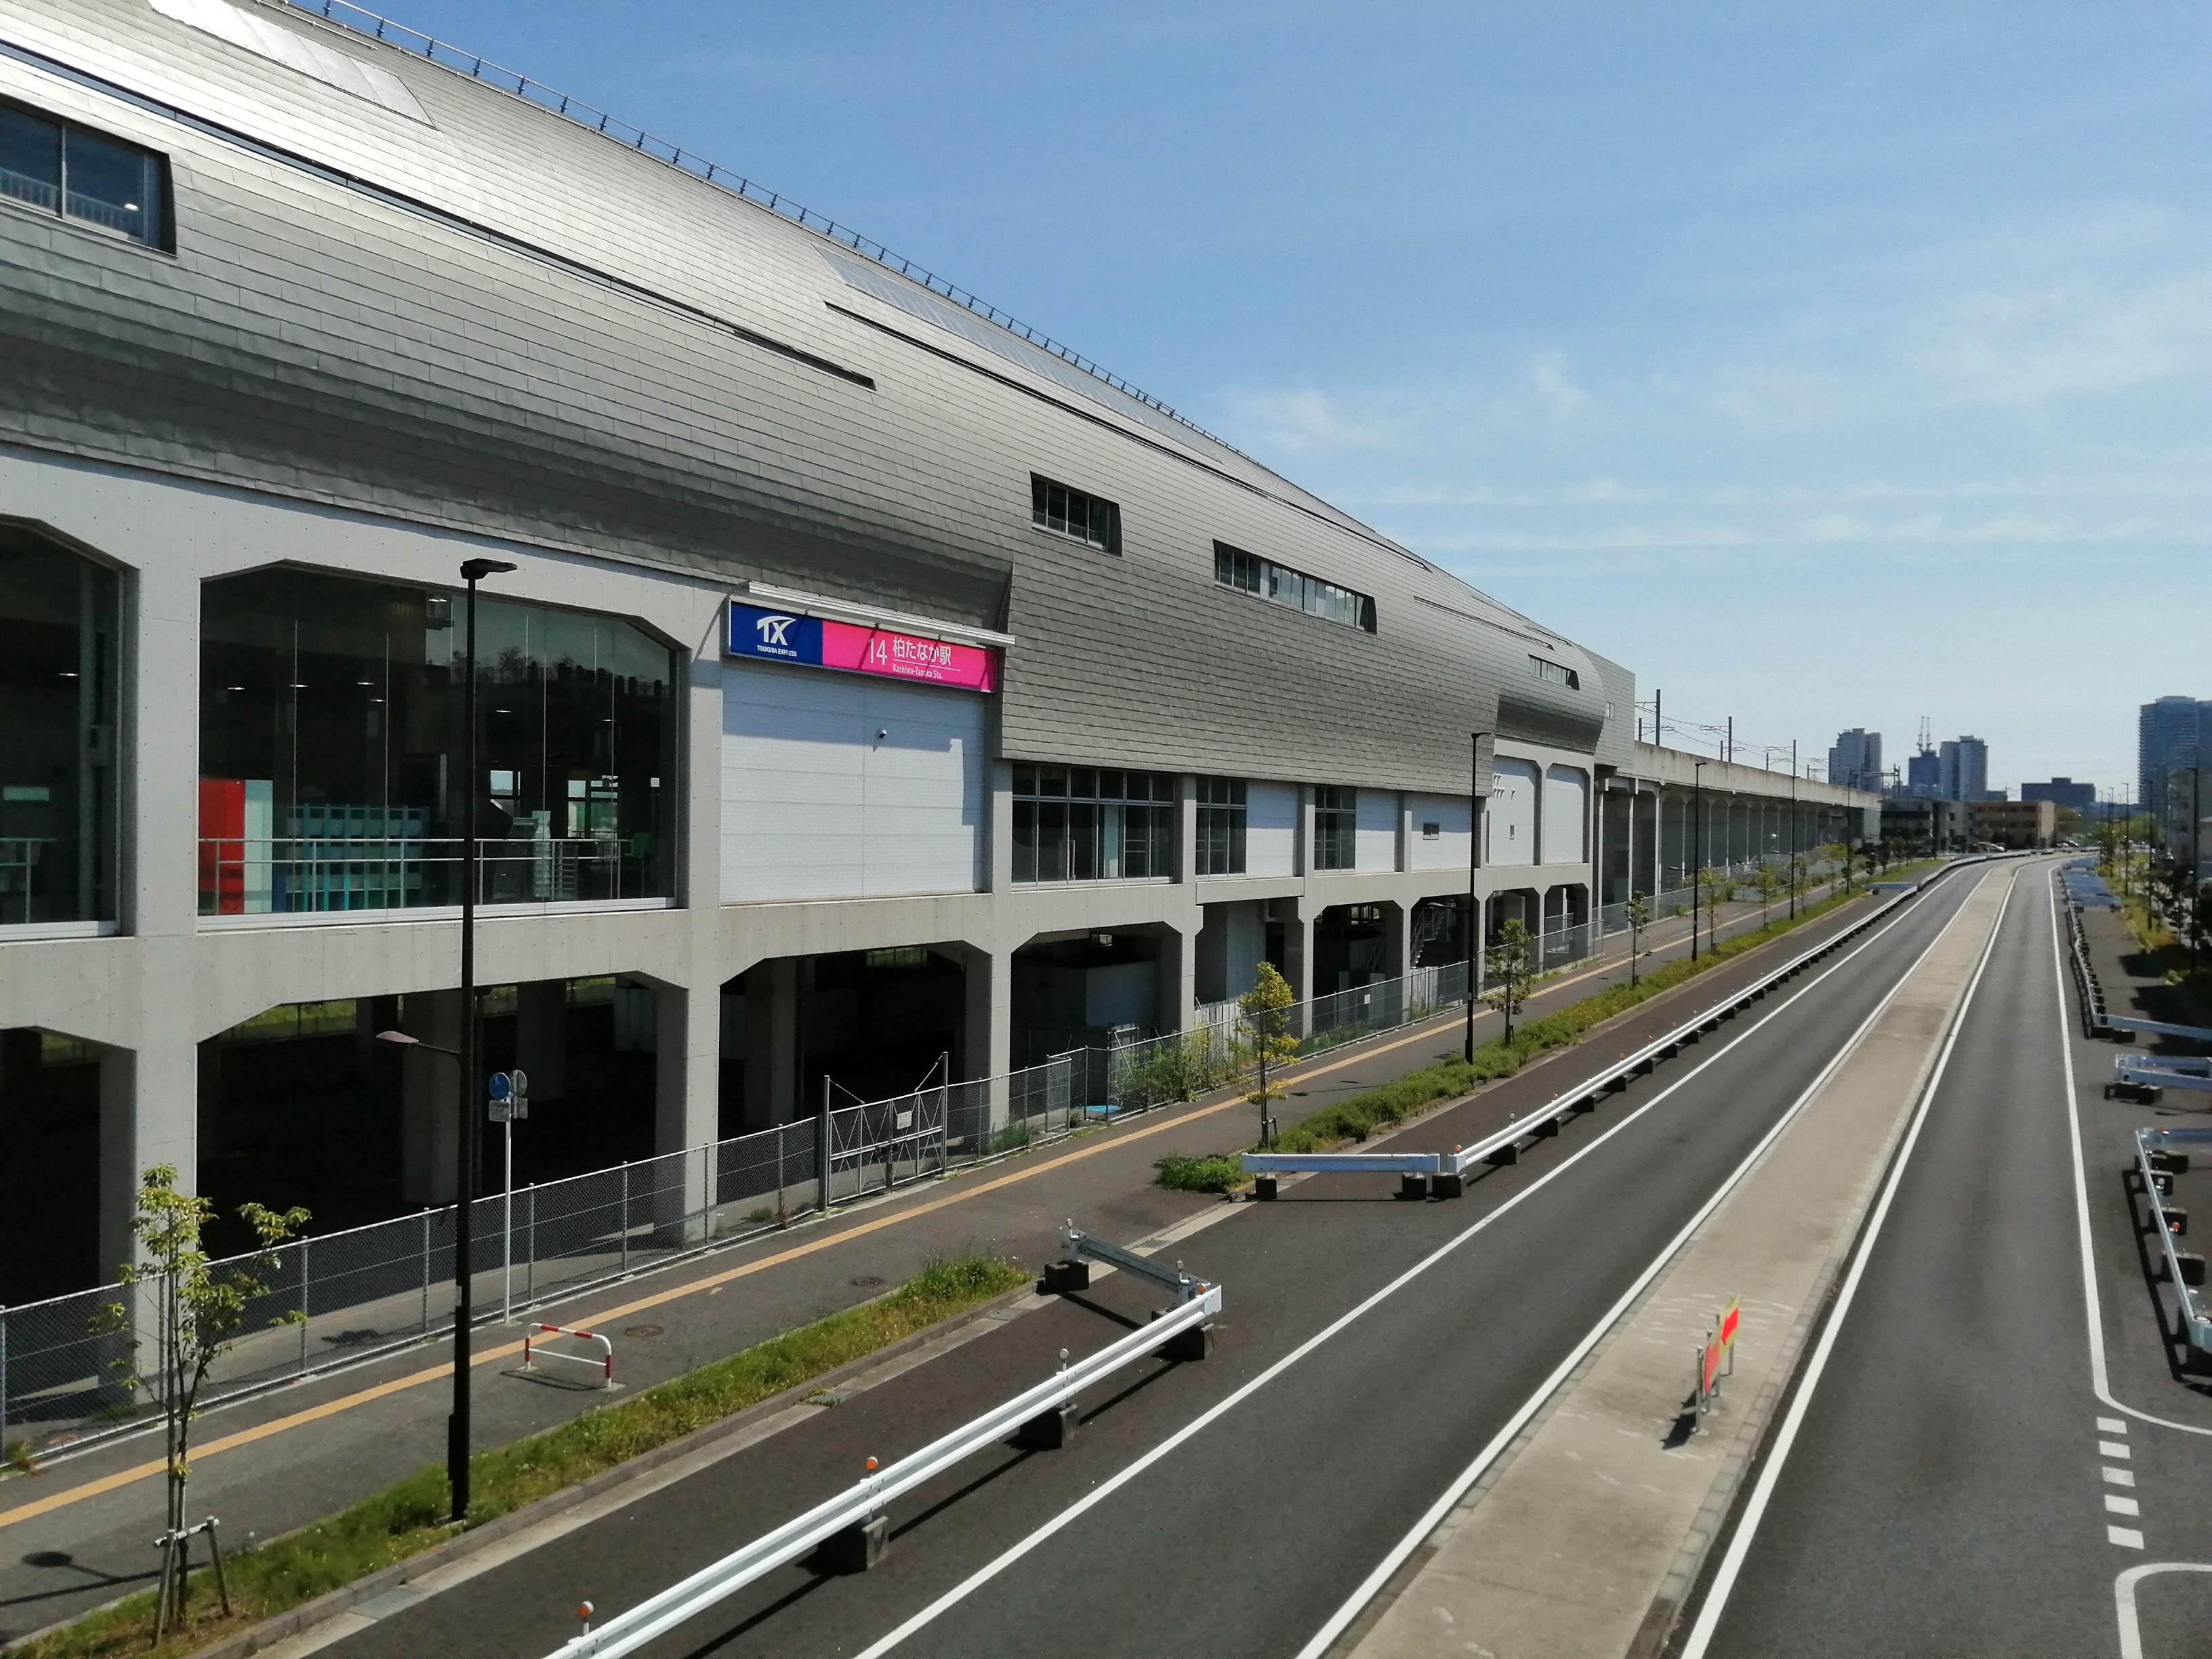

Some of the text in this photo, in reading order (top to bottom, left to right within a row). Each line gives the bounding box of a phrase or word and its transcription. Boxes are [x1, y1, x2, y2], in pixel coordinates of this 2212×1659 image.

[757, 615, 797, 646] TX
[757, 644, 798, 657] TSUKUBA EXPRESS
[869, 638, 888, 665] 14
[893, 636, 951, 665] 柏たなか駅
[893, 663, 933, 678] Kashiwa-Tanaka
